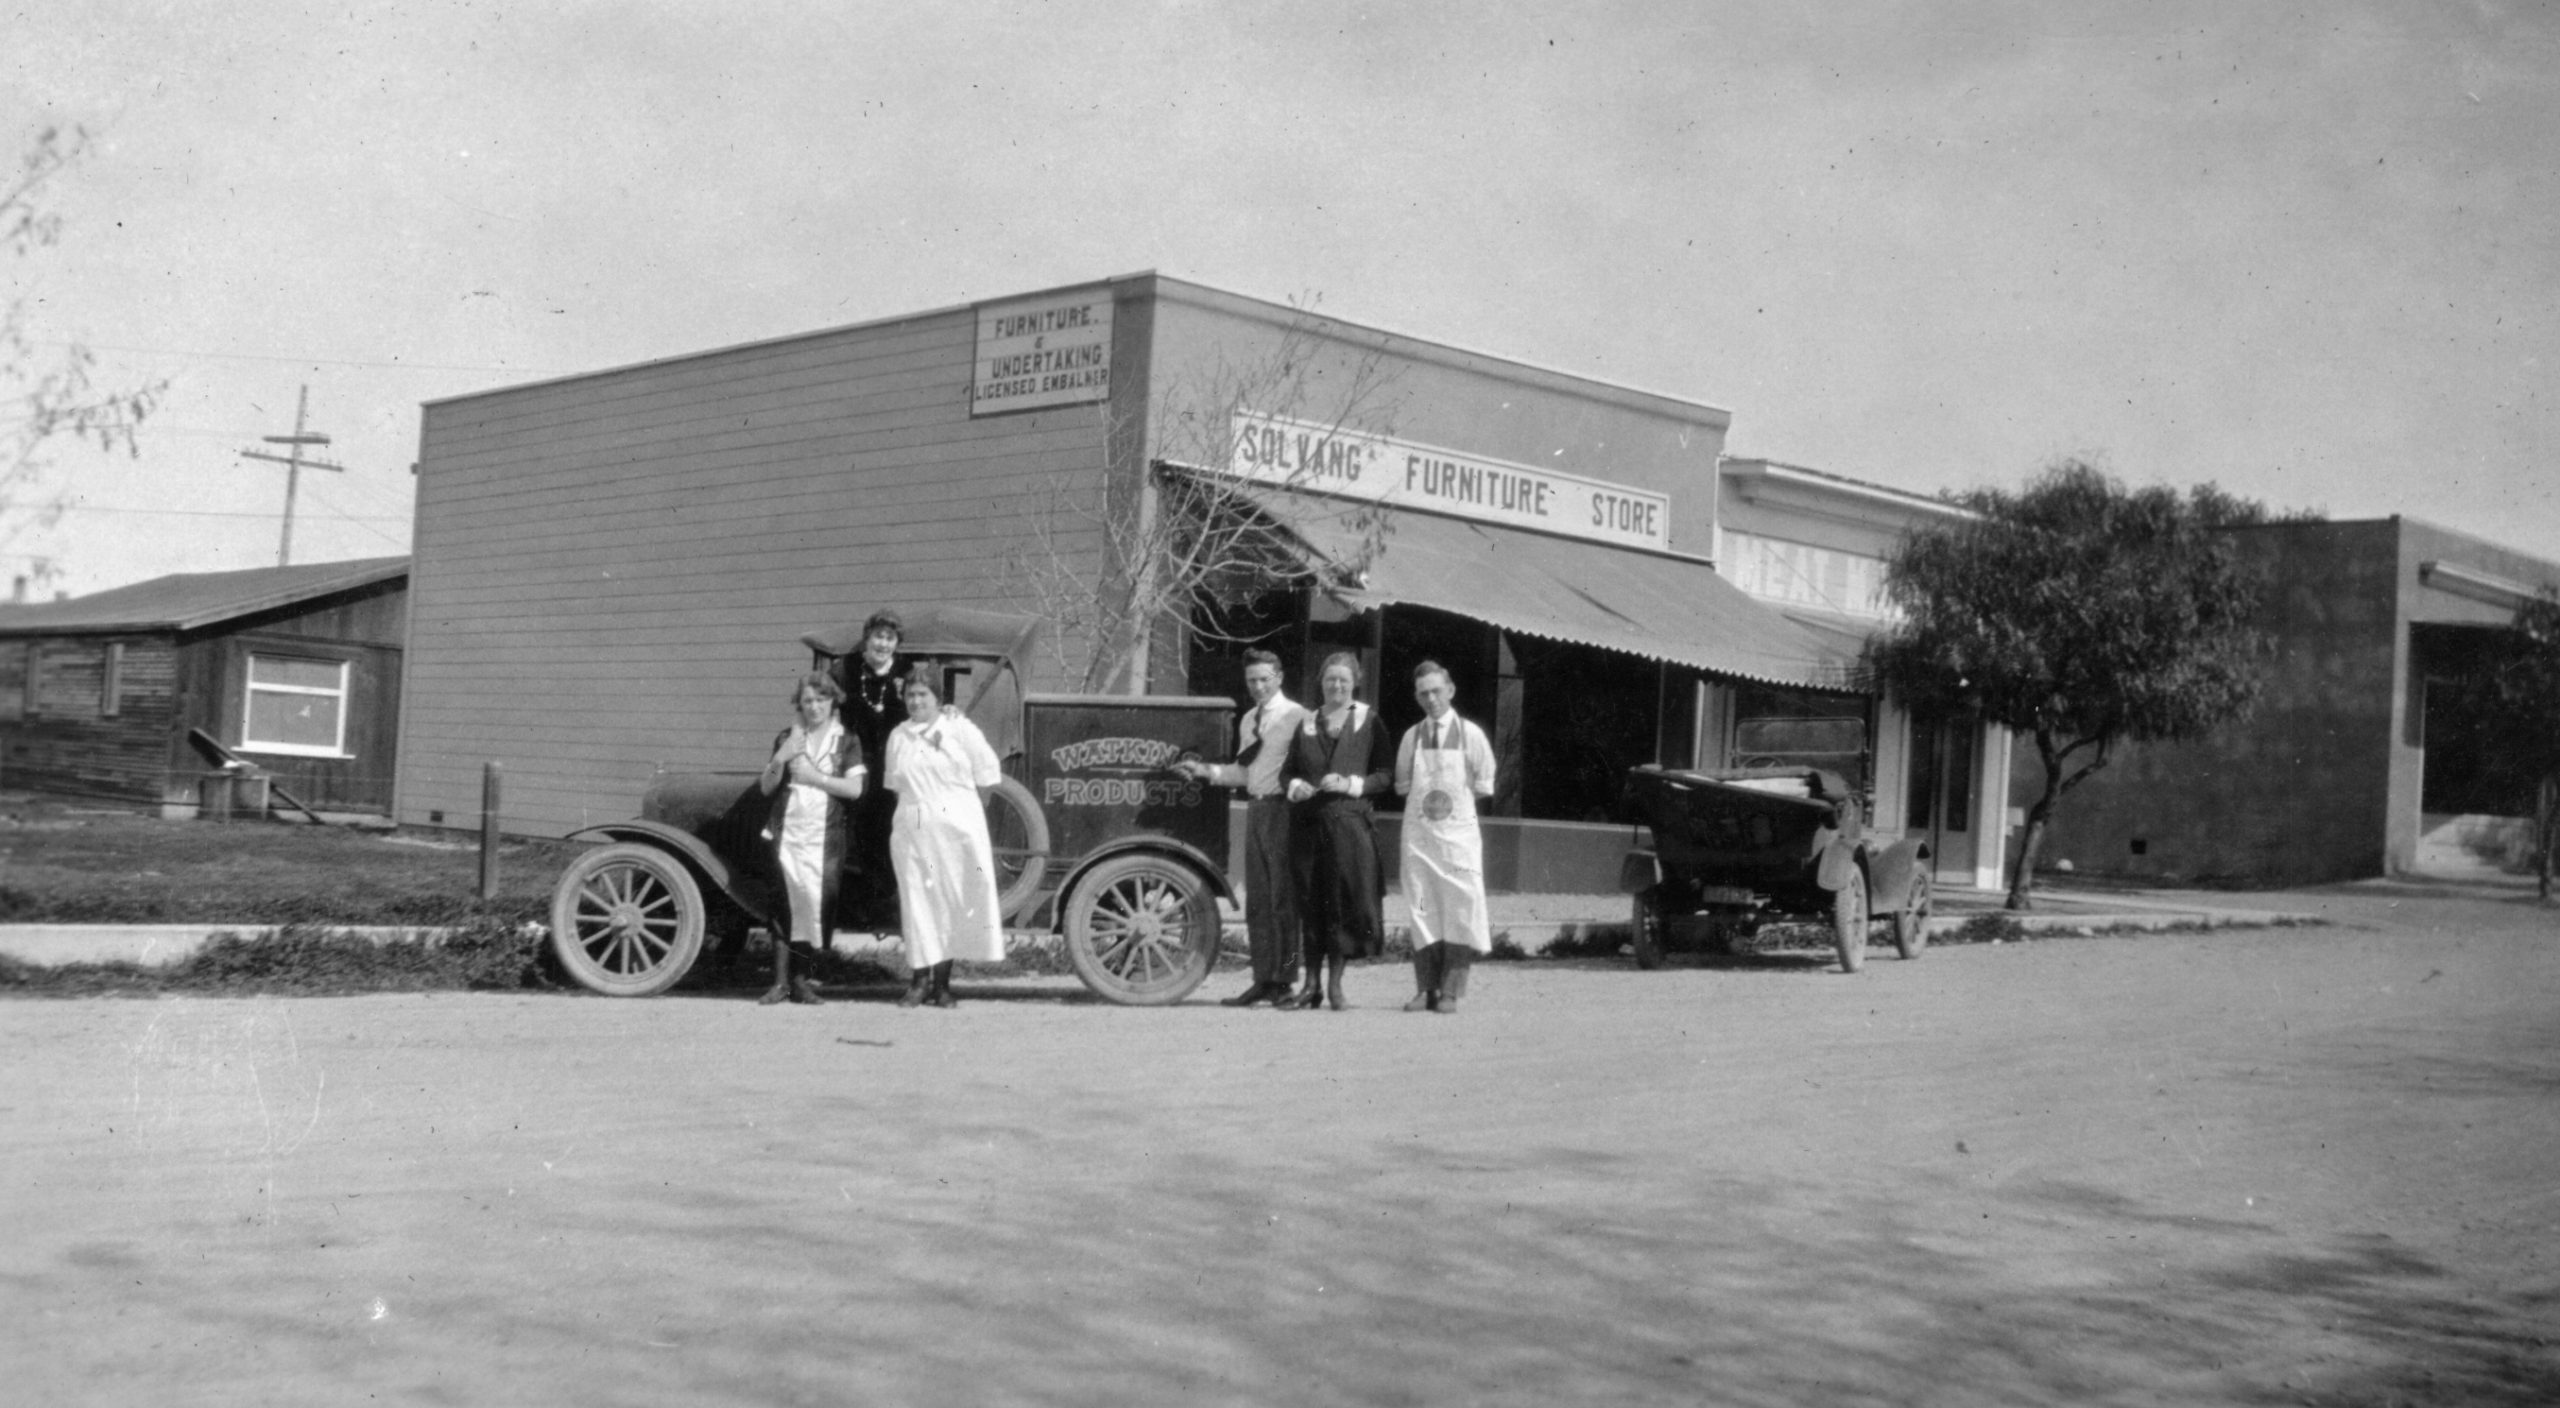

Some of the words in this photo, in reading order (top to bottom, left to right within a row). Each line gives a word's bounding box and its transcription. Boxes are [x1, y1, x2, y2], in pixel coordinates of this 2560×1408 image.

[992, 344, 1102, 379] UNDERTAKING
[975, 377, 1037, 401] LICENSED
[1241, 424, 1361, 482] SOLVANG
[1405, 456, 1549, 516] FURNITURE
[1592, 492, 1658, 537] STORE
[1044, 777, 1204, 808] PRODUCTS
